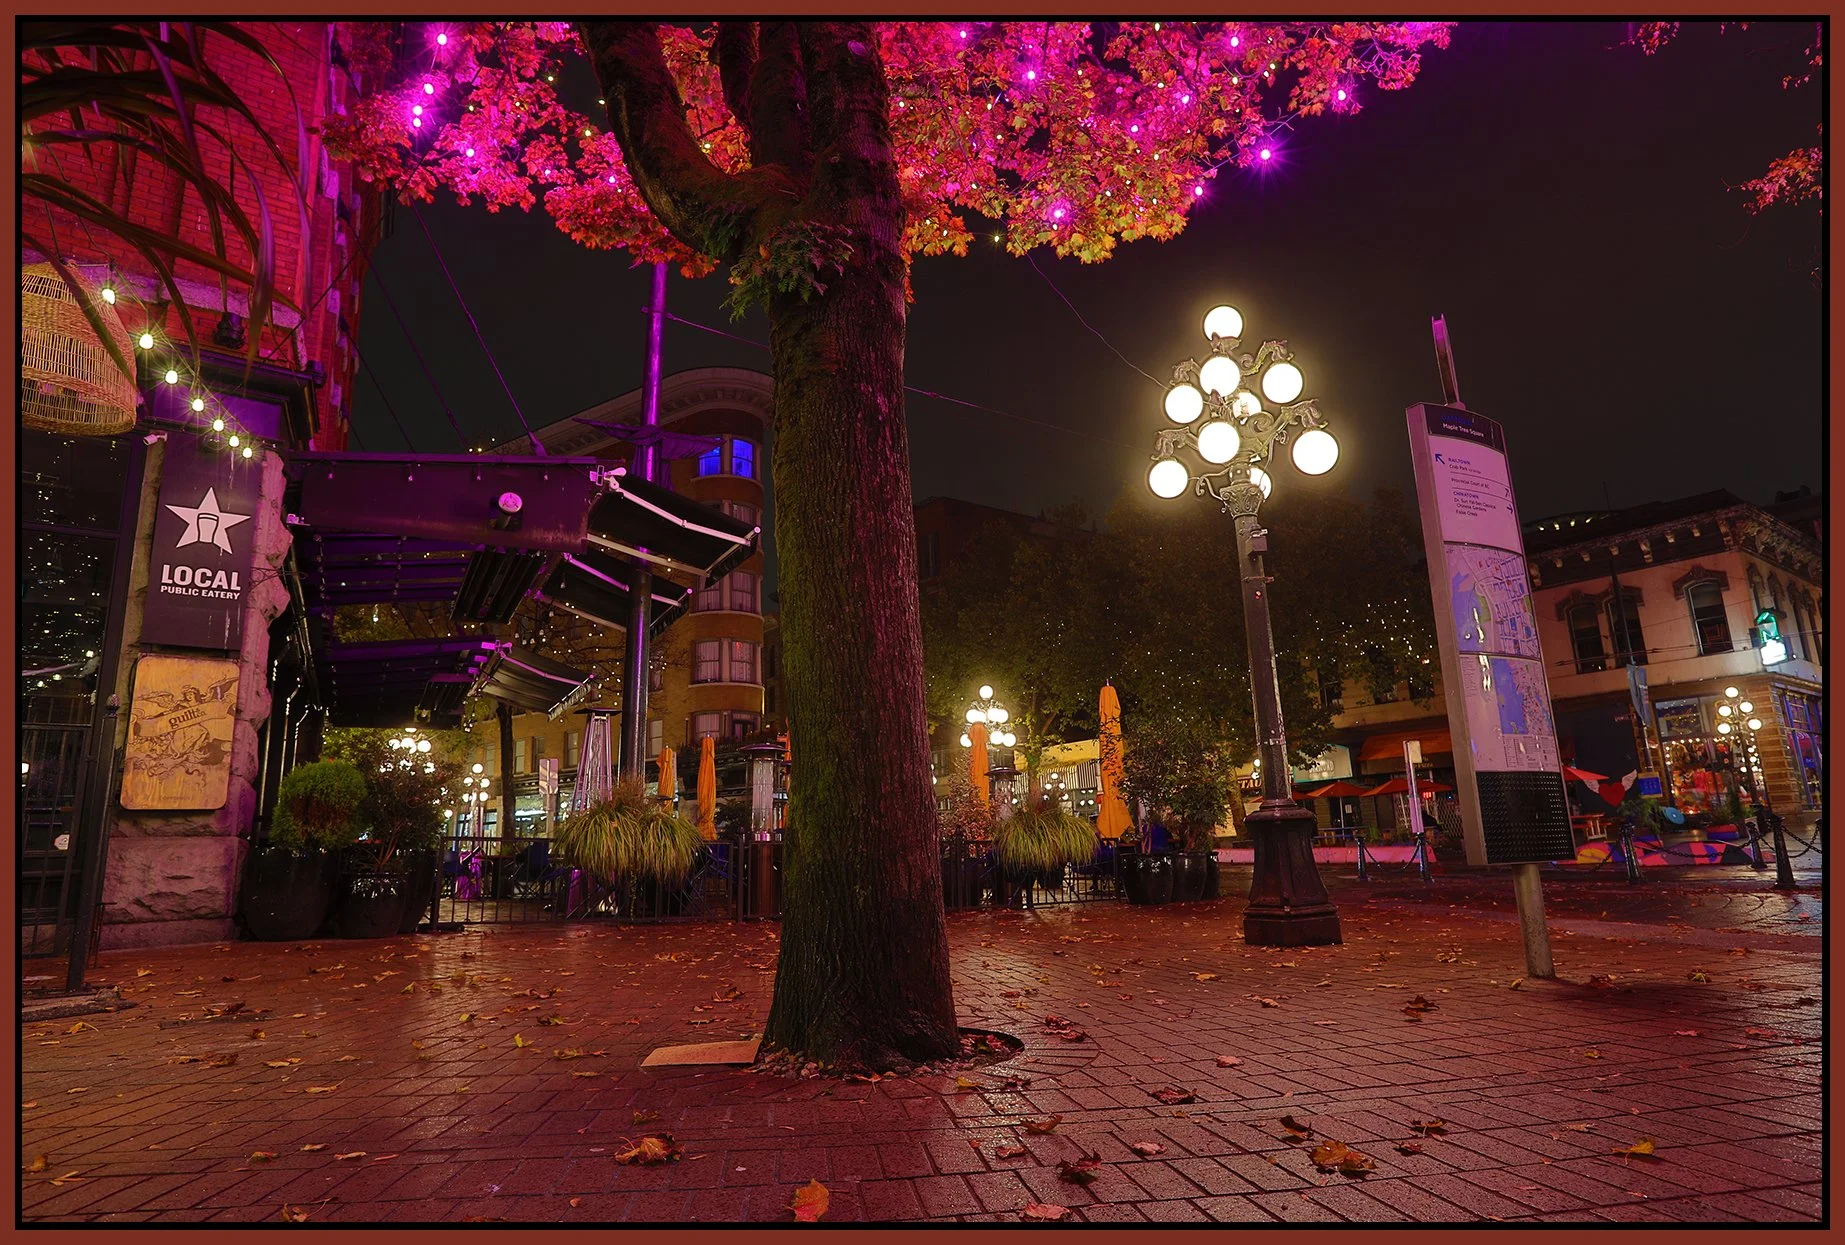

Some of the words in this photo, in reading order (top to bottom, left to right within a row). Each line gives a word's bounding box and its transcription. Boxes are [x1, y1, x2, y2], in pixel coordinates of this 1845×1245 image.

[1442, 422, 1458, 431] Maple
[1458, 425, 1469, 434] Tree
[1469, 428, 1485, 438] Square
[1453, 491, 1479, 499] CHINATOWN
[161, 564, 241, 591] LOCAL
[160, 585, 199, 596] PUBLIC
[201, 589, 241, 600] EATERY
[169, 708, 197, 729] guilt
